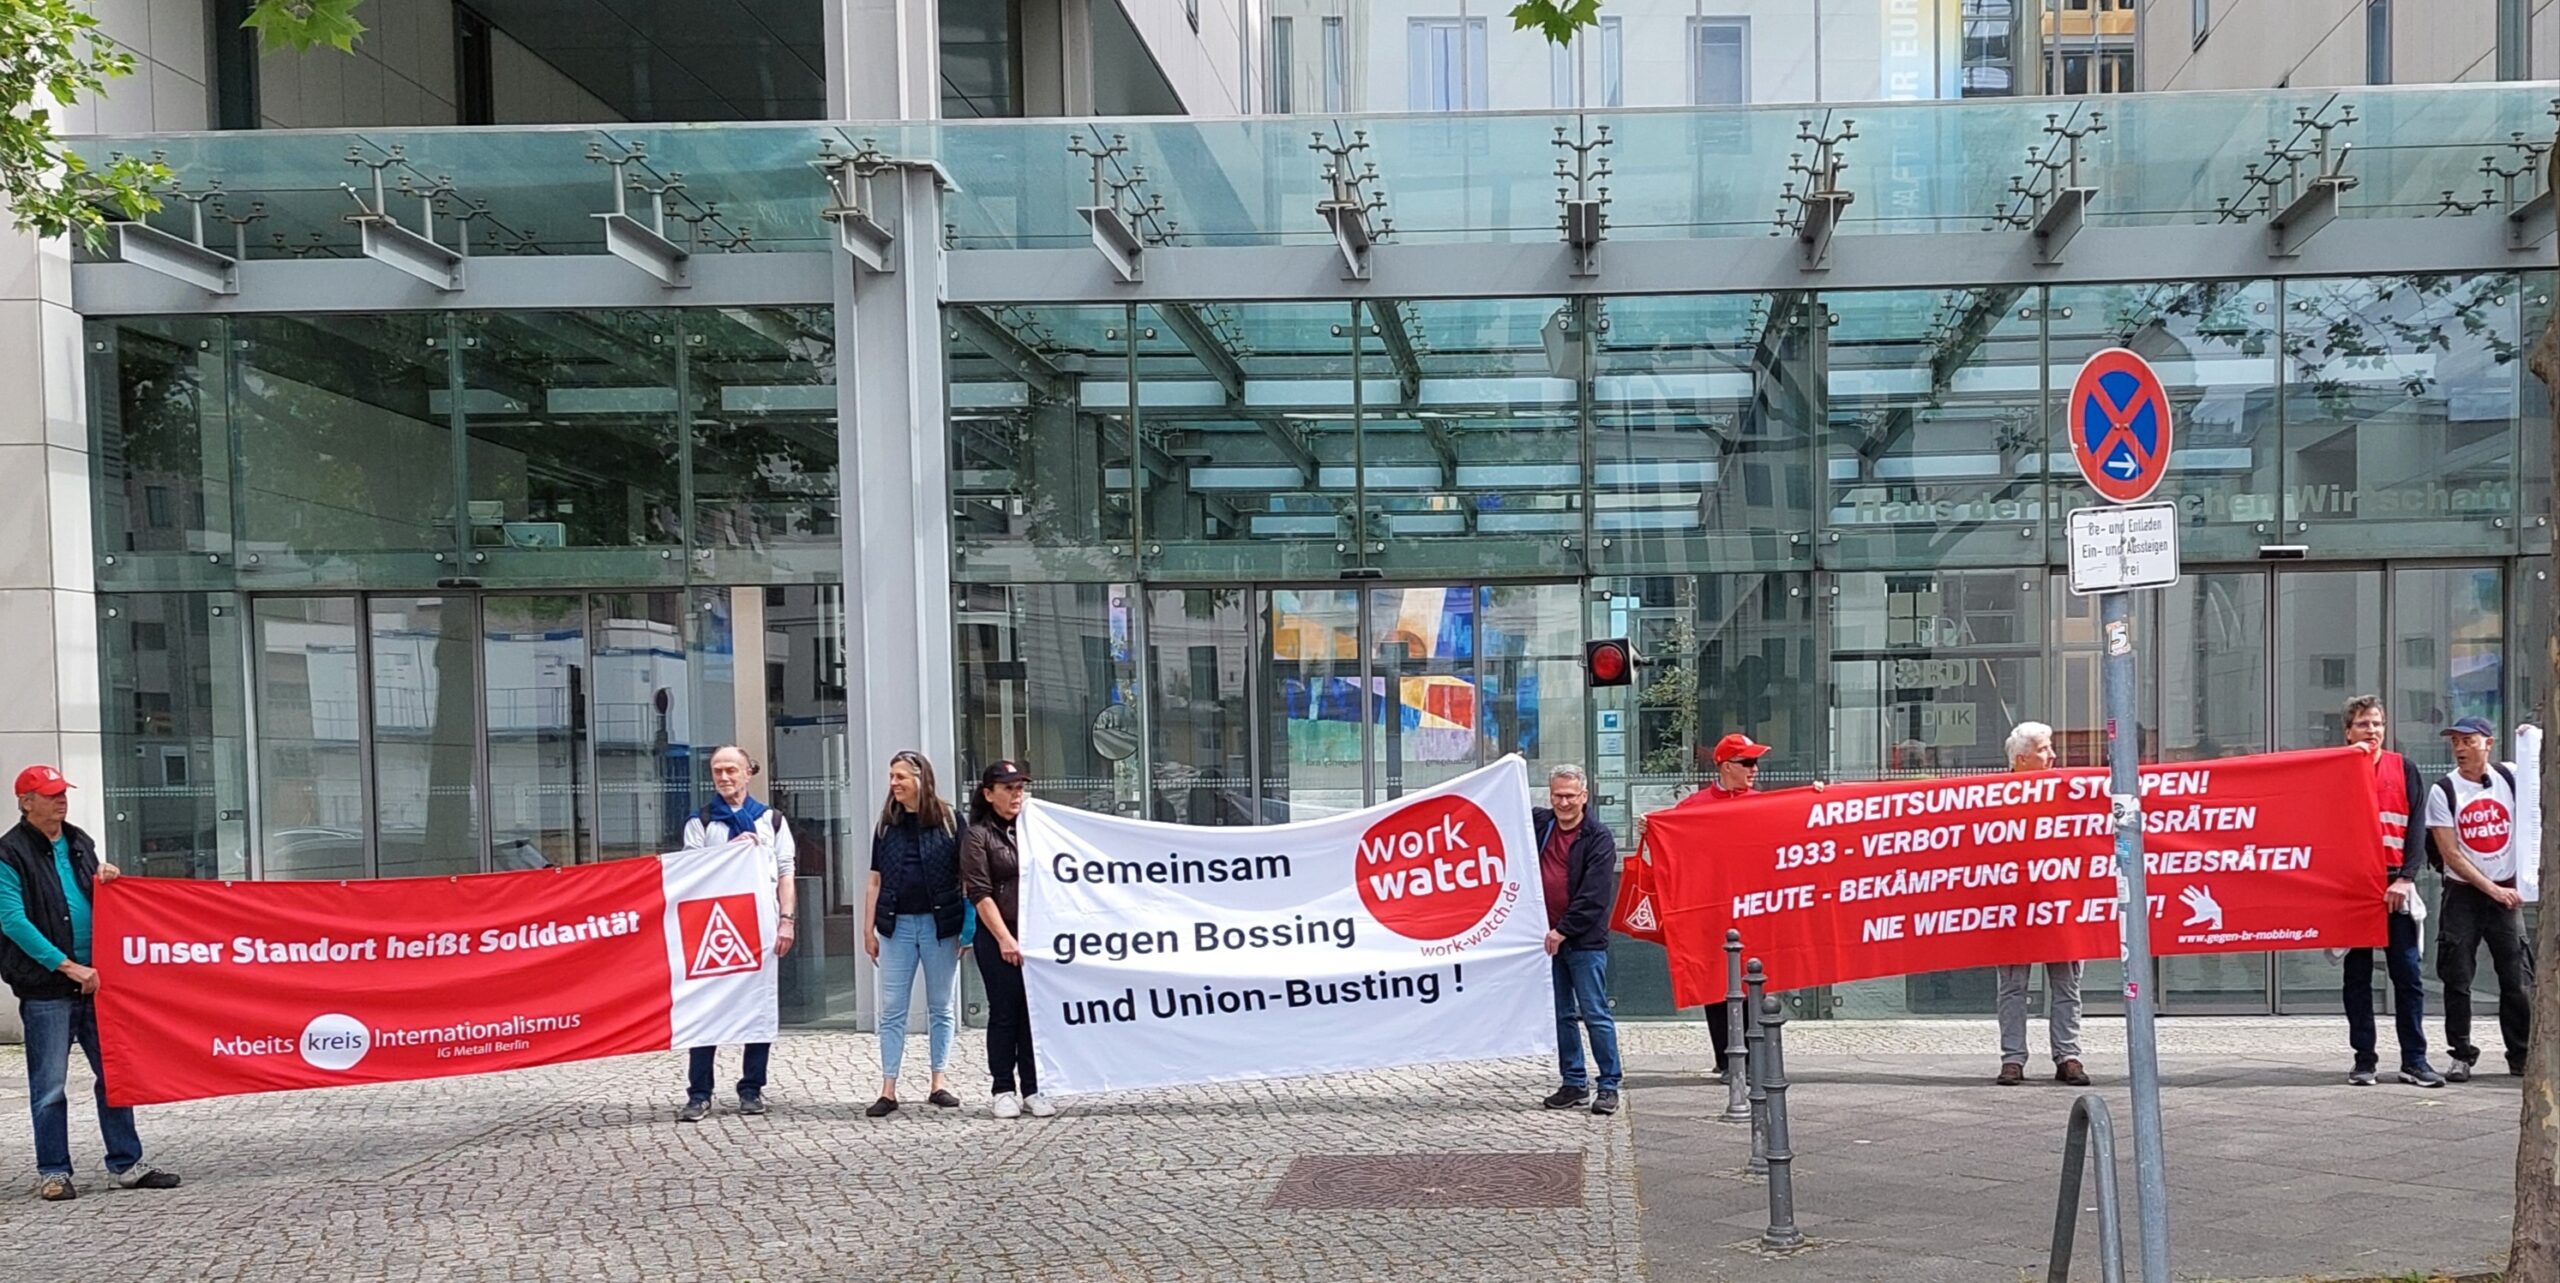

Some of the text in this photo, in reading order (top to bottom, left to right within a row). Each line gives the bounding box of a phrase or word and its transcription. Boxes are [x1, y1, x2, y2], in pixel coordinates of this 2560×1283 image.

[1854, 491, 1954, 522] Haus
[1969, 492, 2034, 520] der
[2062, 487, 2275, 518] Dchen
[2109, 518, 2125, 535] und
[2128, 517, 2162, 533] Entladen
[2082, 540, 2168, 558] Ein- und Aussteigen
[1807, 769, 2211, 829] ARBEITSUNRECHT STPEN!
[2458, 804, 2501, 824] work
[1360, 813, 1470, 865] work
[1775, 839, 1837, 870] 1933
[1861, 823, 1966, 859] VERBOT
[1972, 818, 2027, 846] VON
[2034, 804, 2257, 841] BETRISRÄTEN
[2463, 818, 2511, 839] watch
[1052, 852, 1291, 884] Gemeinsam
[1369, 845, 1506, 902] watch
[1732, 884, 1816, 920] HEUTE
[1839, 861, 2019, 903] BEKÄMPFUNG
[2027, 856, 2081, 883] VON
[2088, 844, 2312, 879] BRIEBSRÄTEN
[122, 910, 640, 965] Unser Standort heißt Solidarität
[1053, 914, 1356, 964] gegen Bossing
[1420, 881, 1521, 957] work-watch.de
[1862, 894, 2166, 943] NIE WIEDER IST JETT!
[2177, 927, 2320, 945] www.gegen-br-mobbing.de
[1062, 963, 1465, 1026] und Union-Busting !
[212, 1013, 582, 1056] Arbeits kreis Internationalismus
[437, 1039, 530, 1059] IG Metall Berlin
